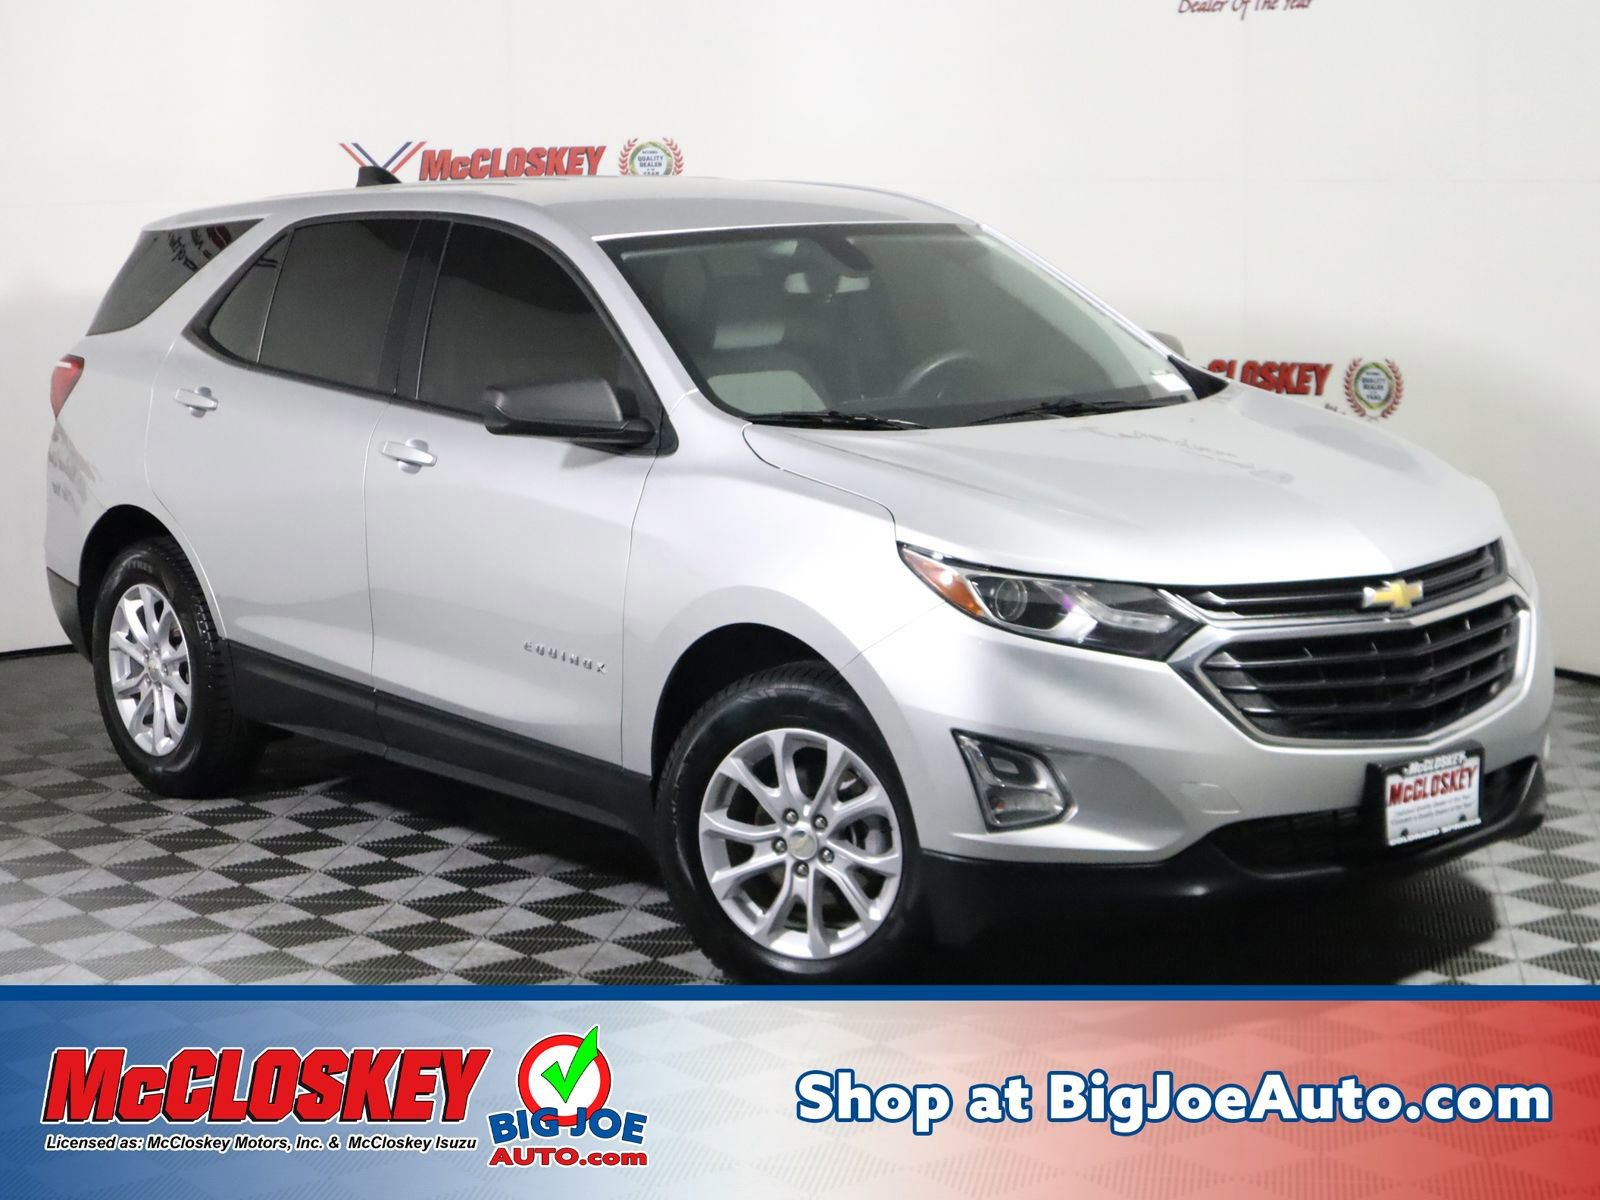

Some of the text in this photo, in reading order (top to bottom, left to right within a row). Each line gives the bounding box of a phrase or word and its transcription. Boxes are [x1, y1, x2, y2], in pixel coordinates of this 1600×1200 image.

[1178, 0, 1228, 13] Dealer
[1231, 0, 1250, 20] Of
[419, 145, 606, 181] McCLOSKEY
[523, 641, 606, 674] EQUINOX
[1387, 764, 1478, 807] McCLOSKEY
